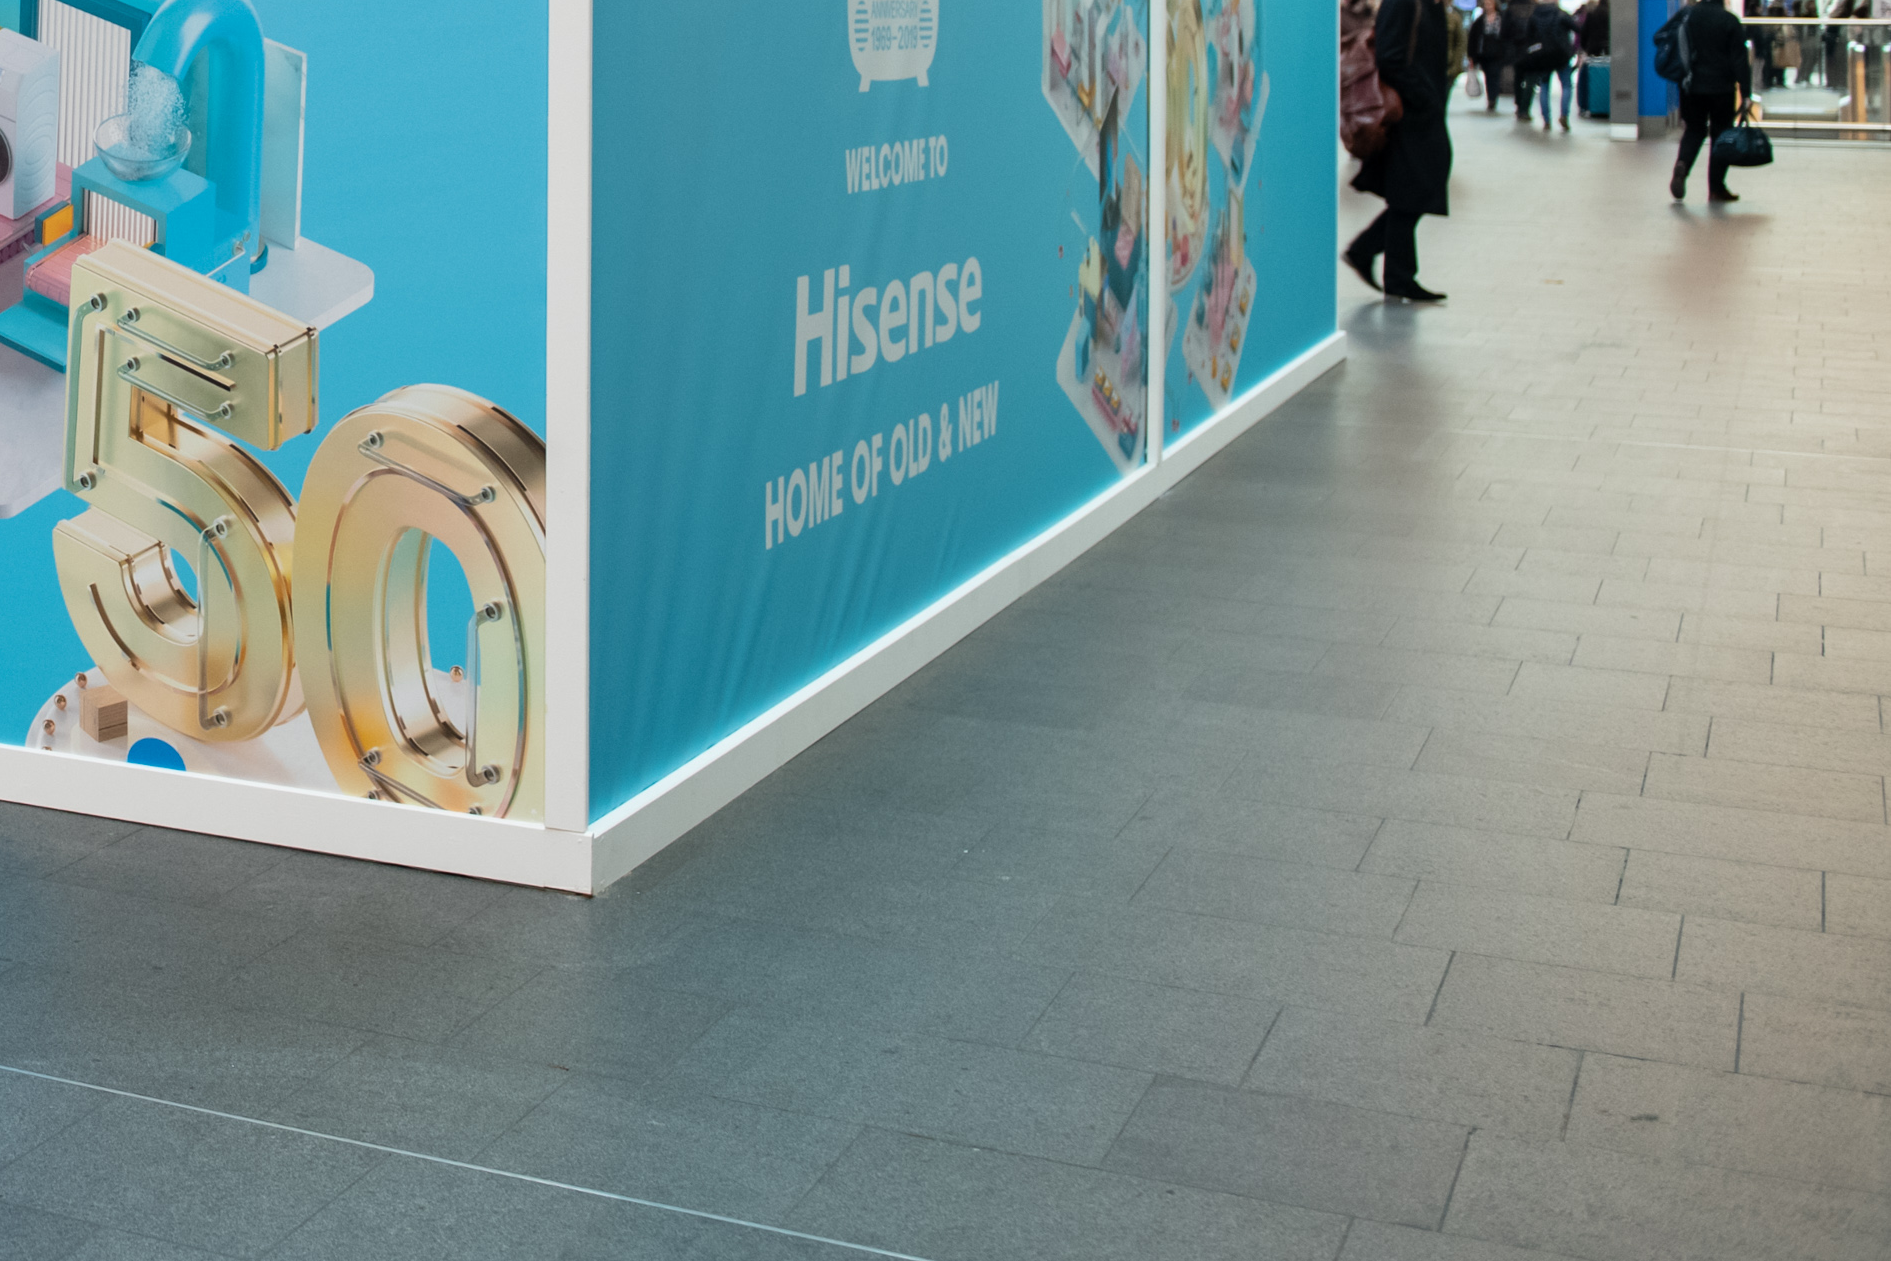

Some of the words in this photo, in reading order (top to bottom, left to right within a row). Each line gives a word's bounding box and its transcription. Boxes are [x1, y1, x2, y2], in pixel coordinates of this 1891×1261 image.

[870, 0, 919, 20] ANNIVERSARY
[845, 138, 926, 194] WELCOME
[928, 135, 948, 178] TO
[793, 256, 983, 397] Hisense
[765, 450, 843, 550] HOME
[851, 433, 883, 504] OF
[889, 413, 932, 486] OLD
[938, 402, 952, 462] &
[959, 380, 999, 452] NEW
